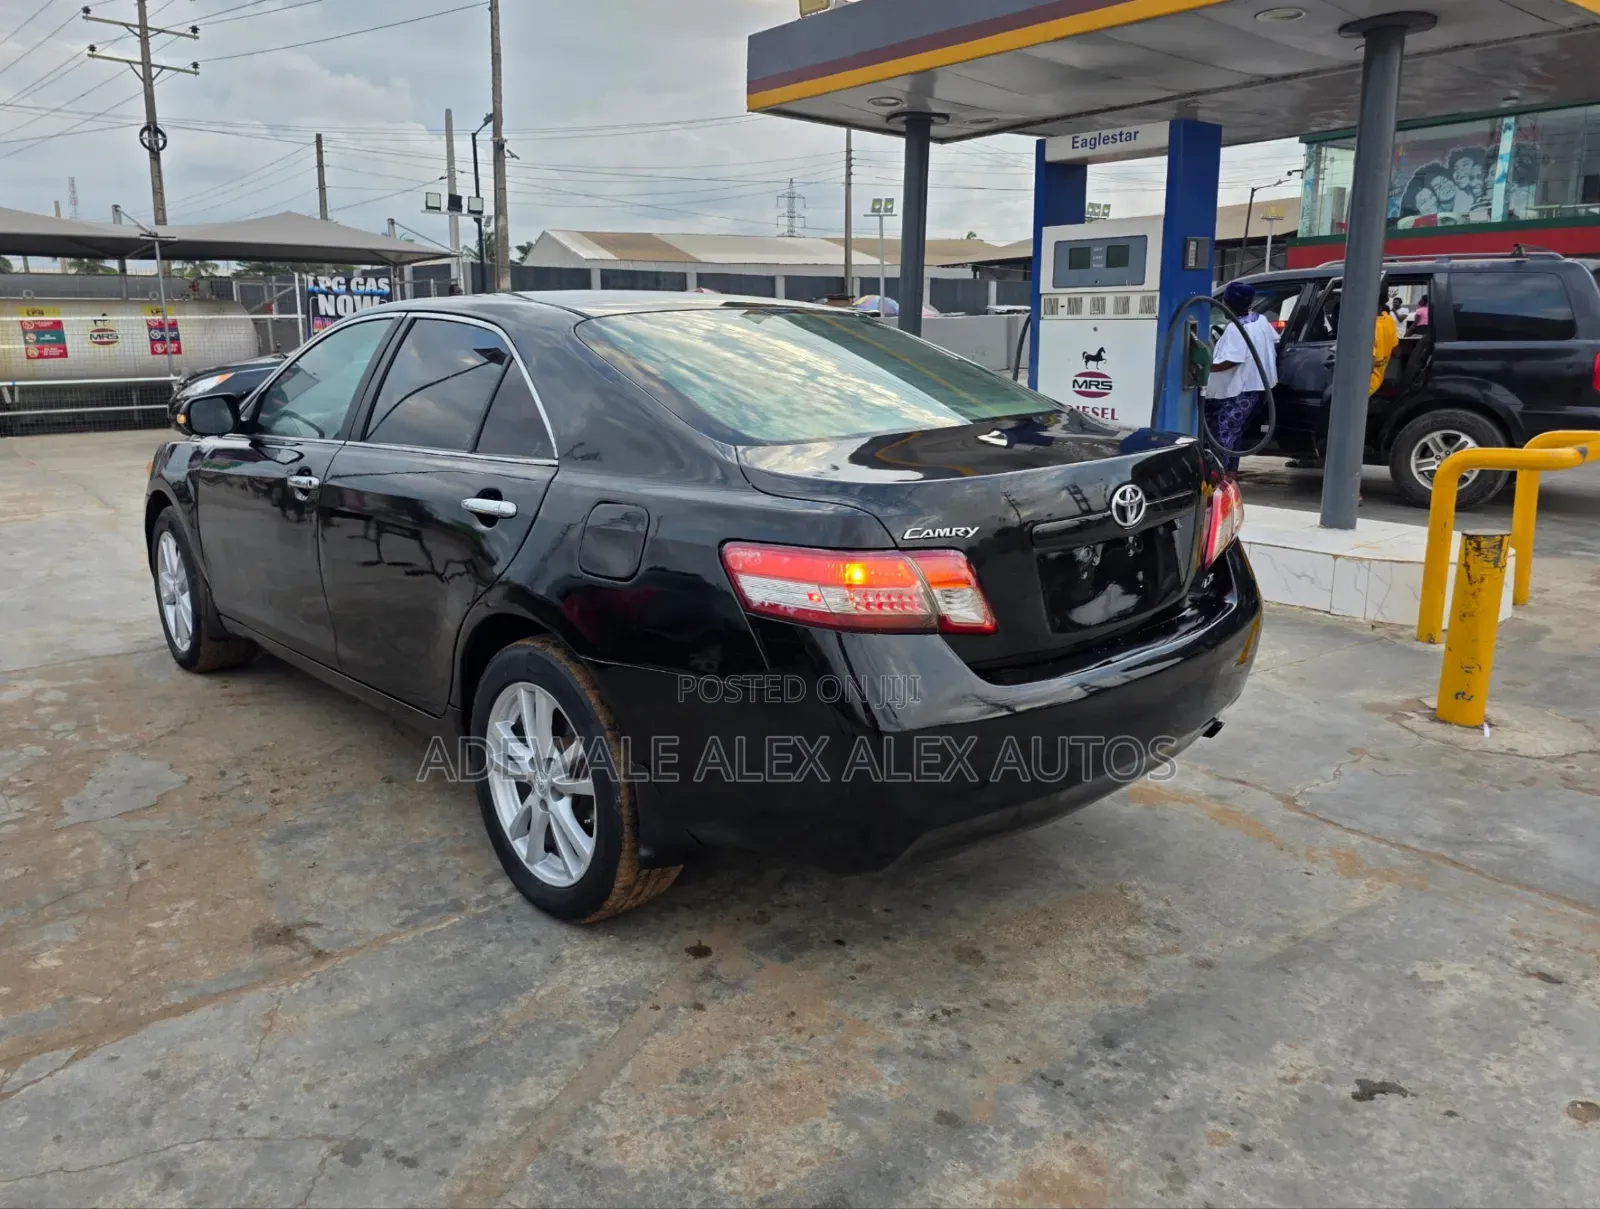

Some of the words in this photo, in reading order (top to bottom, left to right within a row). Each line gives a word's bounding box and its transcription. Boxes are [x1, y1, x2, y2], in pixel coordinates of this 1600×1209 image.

[1071, 130, 1140, 150] Eaglestar
[350, 276, 391, 295] GAS
[317, 293, 381, 317] NOW
[89, 333, 119, 341] MRS
[1072, 379, 1113, 391] MRS
[1067, 405, 1119, 421] ESEL
[902, 526, 980, 540] CAMRY
